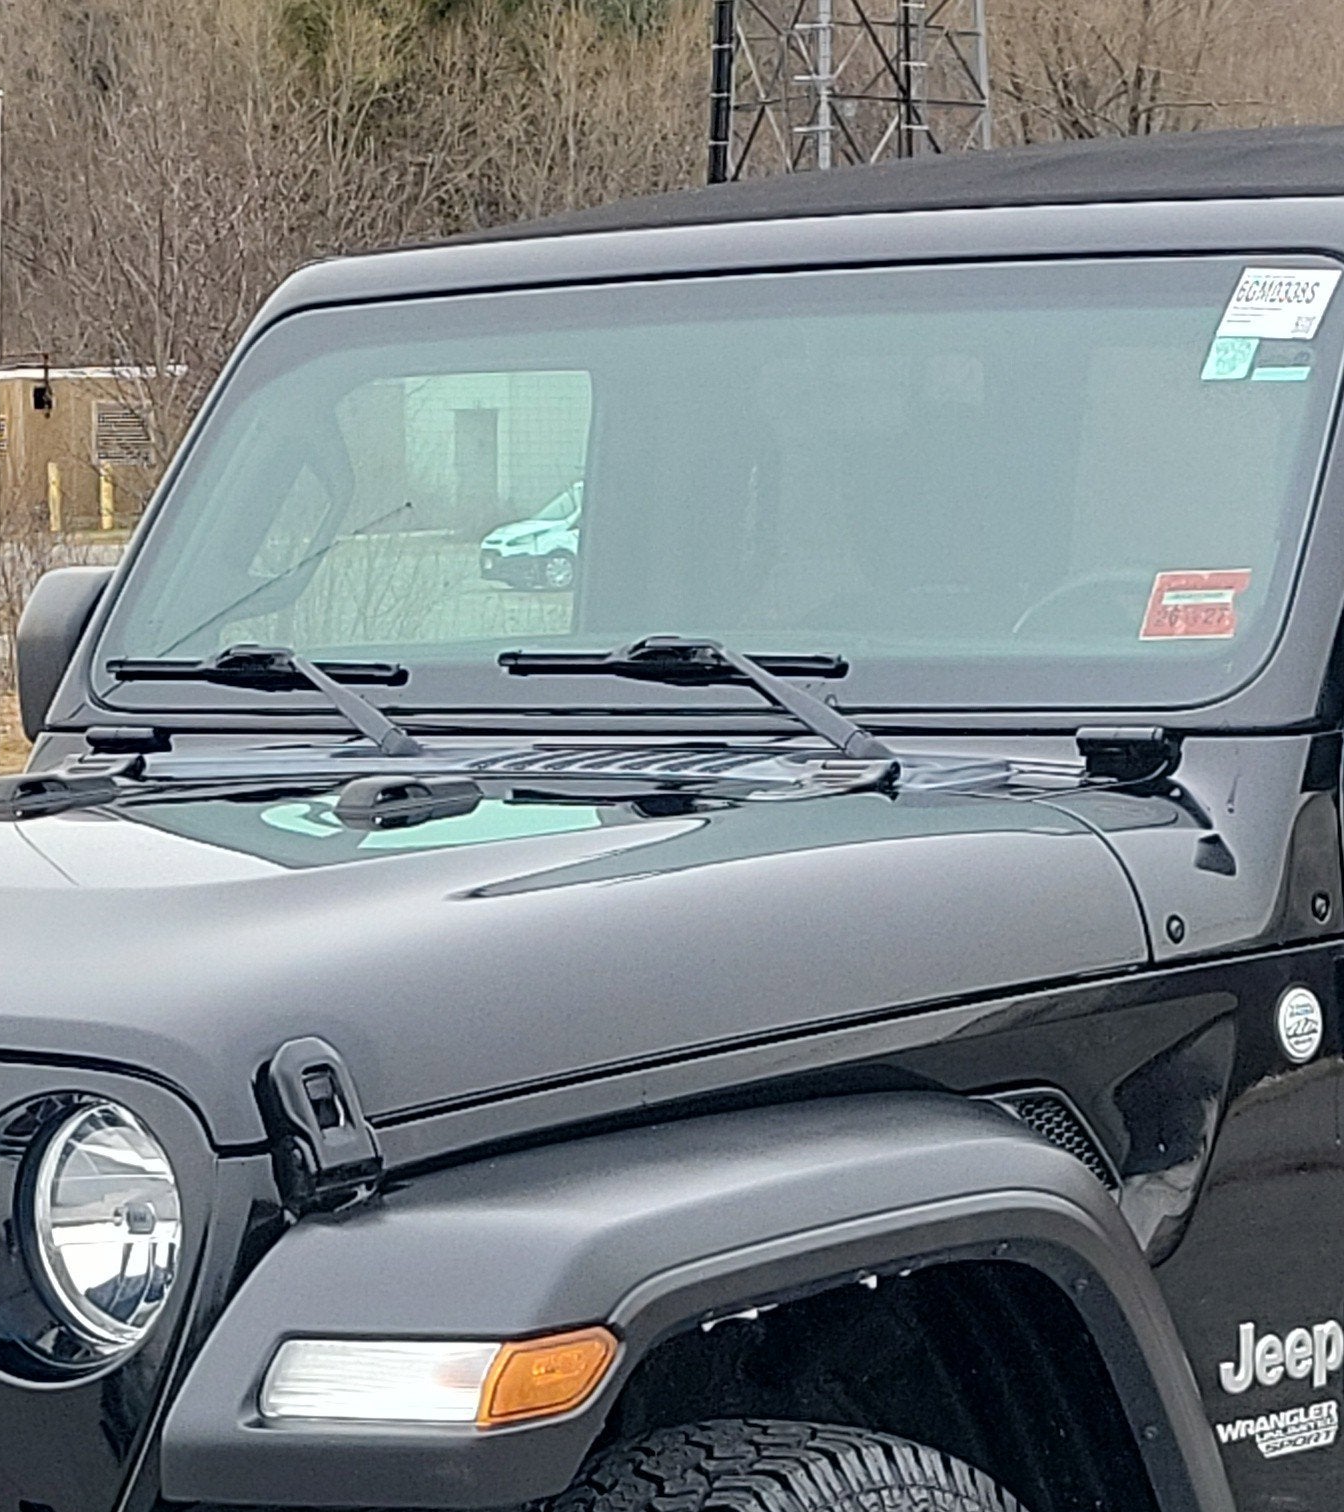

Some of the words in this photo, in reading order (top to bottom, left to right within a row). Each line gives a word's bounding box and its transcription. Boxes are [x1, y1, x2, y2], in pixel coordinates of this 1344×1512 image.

[1219, 1320, 1344, 1394] Jeep
[1216, 1400, 1338, 1443] WRANGLER
[1264, 1429, 1332, 1454] SPORT
